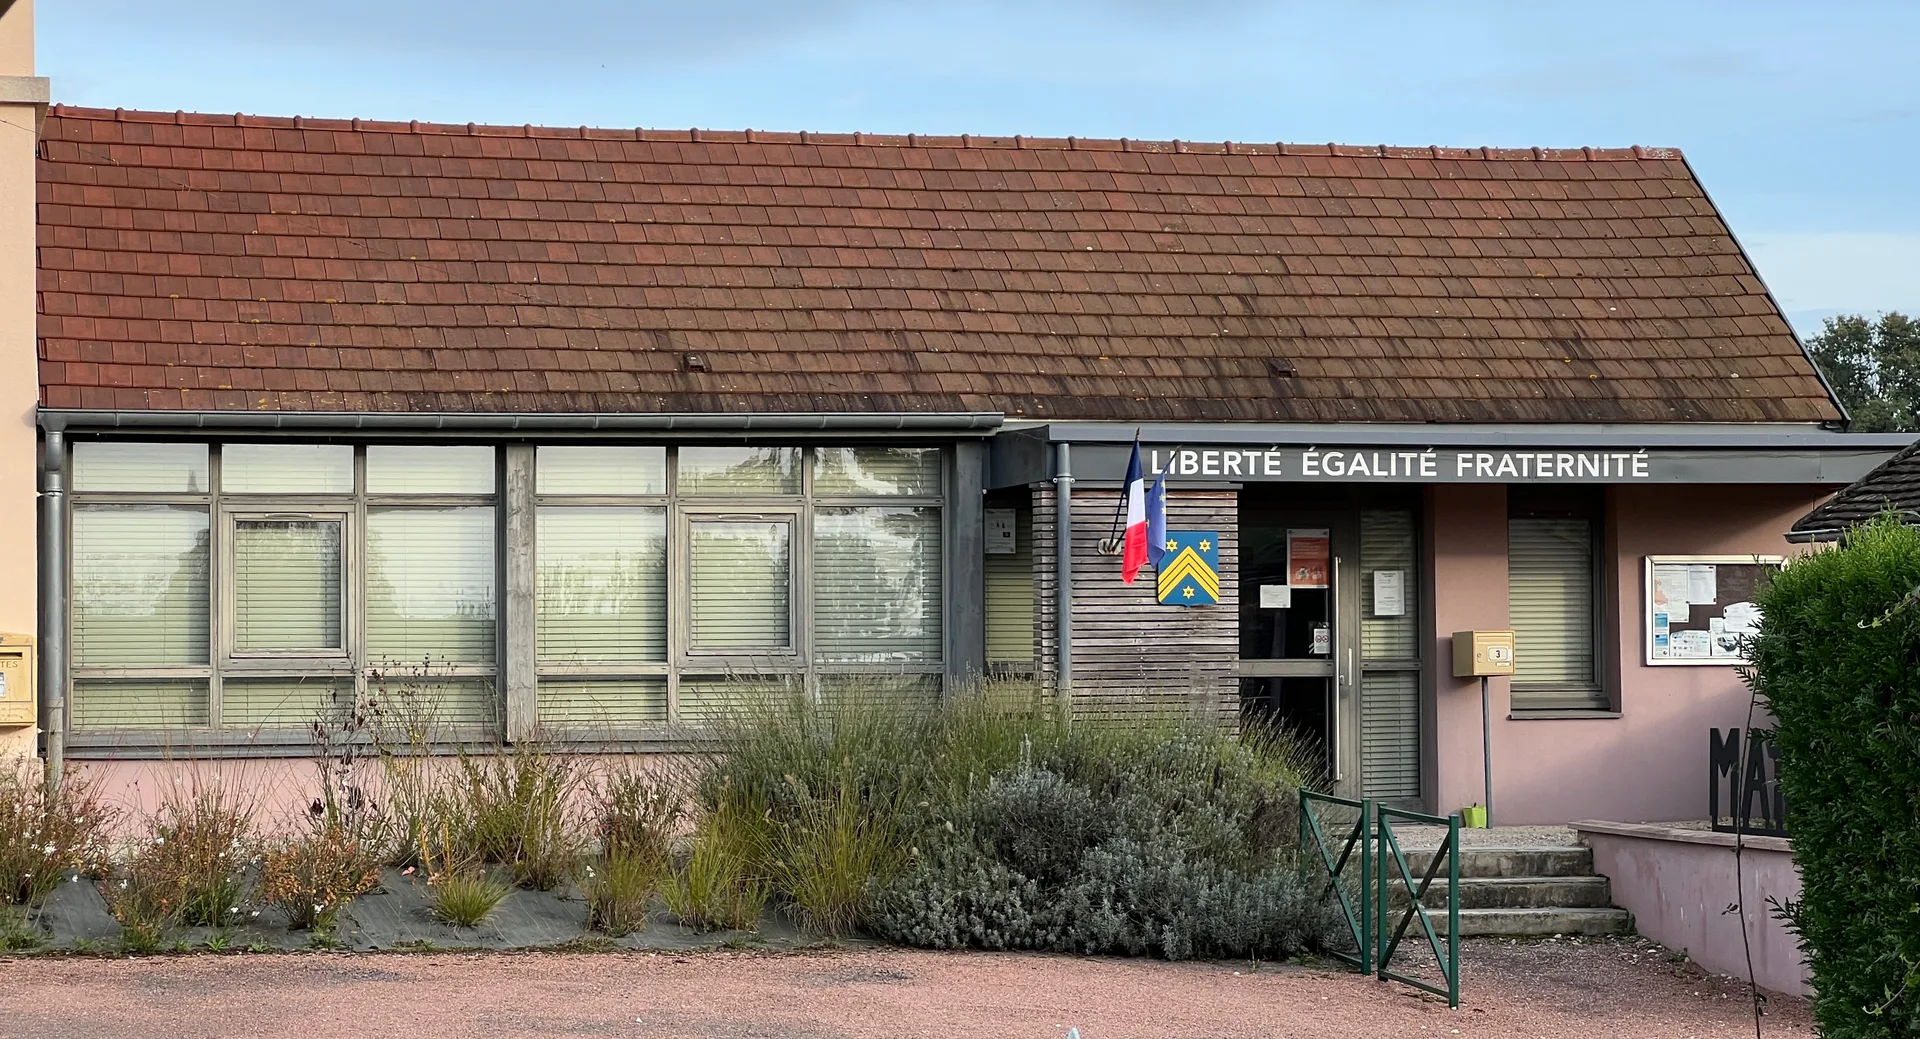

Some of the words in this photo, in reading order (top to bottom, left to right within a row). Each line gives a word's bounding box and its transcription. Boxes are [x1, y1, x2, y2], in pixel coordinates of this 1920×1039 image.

[1151, 446, 1282, 476] LIBERTÉ
[1302, 446, 1437, 477] ÉGALITÉ
[1457, 448, 1649, 477] FRATERNITÉ
[1495, 649, 1501, 659] 3
